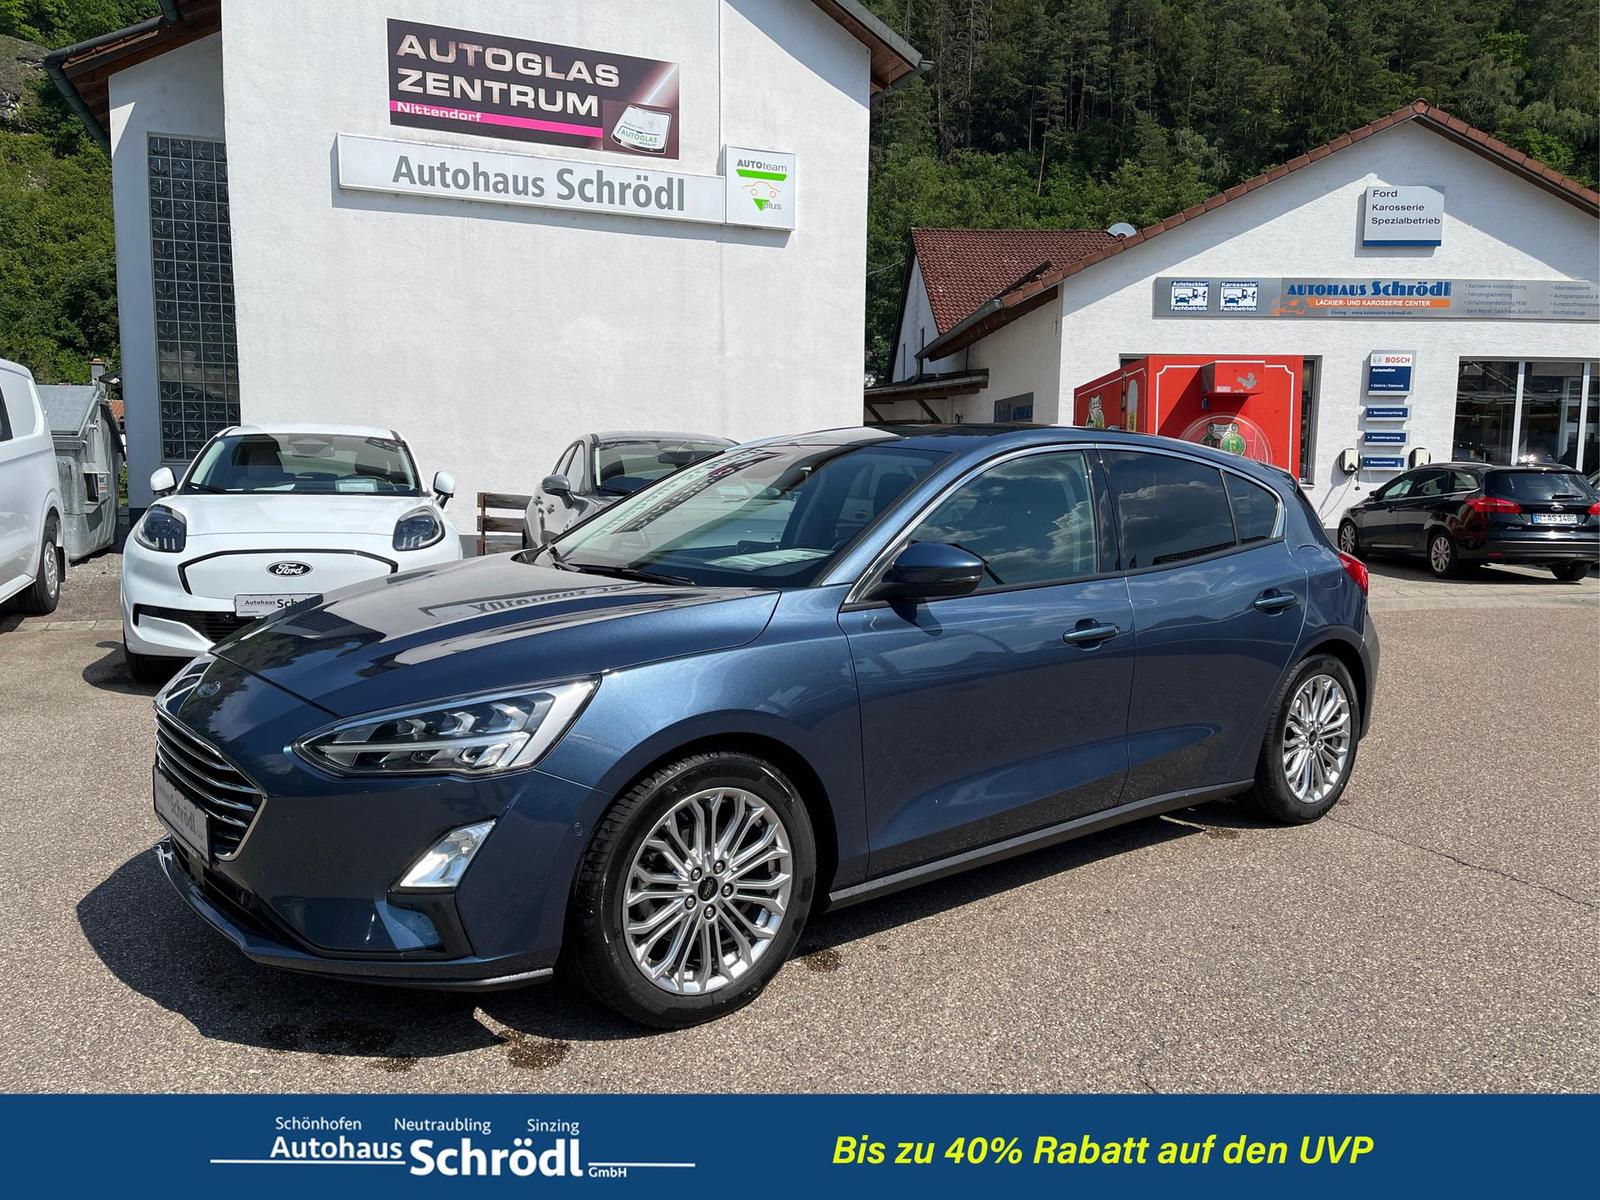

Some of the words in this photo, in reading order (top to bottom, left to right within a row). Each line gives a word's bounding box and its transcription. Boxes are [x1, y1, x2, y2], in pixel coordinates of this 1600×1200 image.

[396, 34, 620, 88] AUTOGLAS
[396, 67, 599, 118] ZENTRUM
[397, 102, 482, 122] Nittendorf
[621, 129, 658, 143] AUTOGLAS
[737, 159, 788, 172] AUTOteam
[392, 155, 545, 199] Autohaus
[556, 168, 685, 212] Schrödl
[1372, 189, 1398, 198] Ford
[1371, 203, 1425, 211] Karosserie
[1371, 217, 1440, 226] Spezialbetrieb
[1287, 284, 1366, 296] AUTOHAUS
[1370, 281, 1449, 296] Schrödl
[1315, 299, 1346, 307] LACKIER-
[1347, 299, 1361, 307] UND
[1362, 299, 1404, 307] KAROSSERIE
[1404, 299, 1431, 307] CENTER
[1385, 356, 1410, 364] BOSCH
[275, 563, 304, 575] Ford
